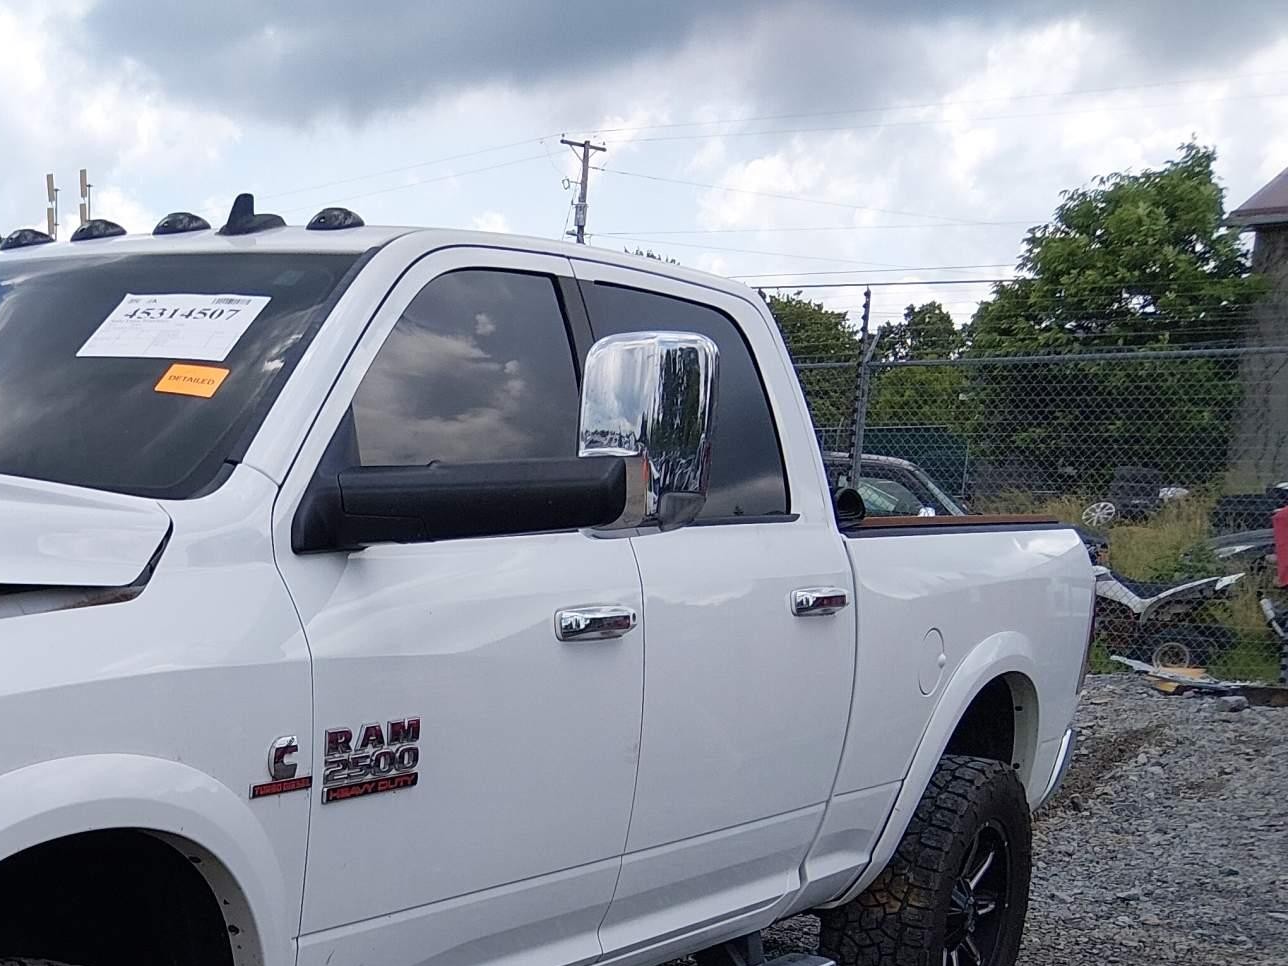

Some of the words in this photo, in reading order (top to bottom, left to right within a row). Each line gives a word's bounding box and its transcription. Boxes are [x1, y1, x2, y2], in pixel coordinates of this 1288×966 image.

[124, 307, 242, 321] 45314507
[167, 374, 216, 386] DETAILED
[324, 717, 421, 756] RAM
[323, 744, 420, 785] 2500
[254, 782, 282, 796] TURBO
[282, 778, 311, 793] DIESEL
[328, 782, 376, 801] HEAVY
[377, 774, 416, 792] DUTY
